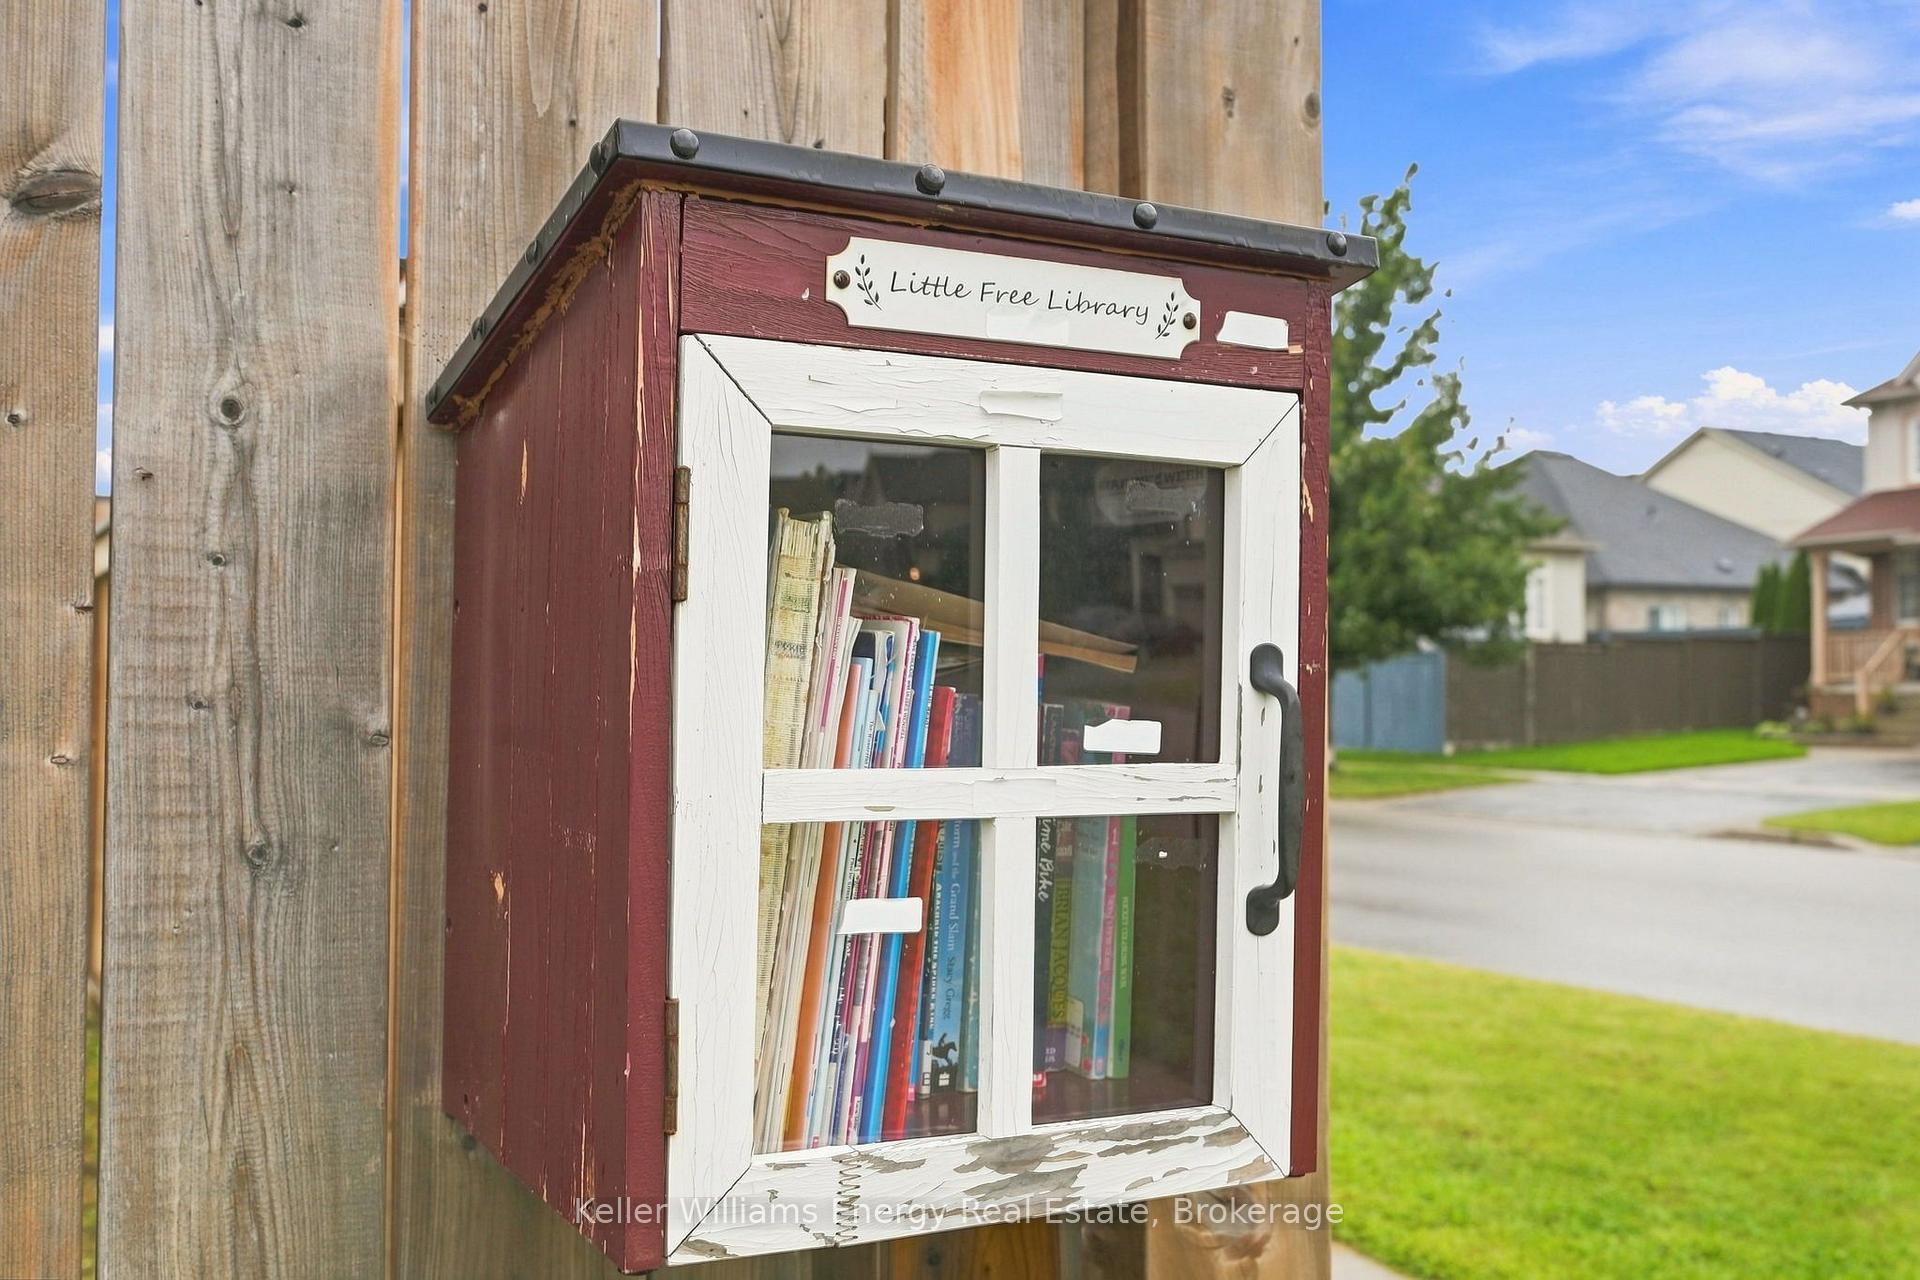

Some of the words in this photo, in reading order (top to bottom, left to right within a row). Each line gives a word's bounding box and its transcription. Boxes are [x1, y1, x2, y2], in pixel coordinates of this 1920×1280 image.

[890, 271, 972, 298] Little
[979, 282, 1039, 306] Free
[1047, 290, 1150, 325] Library
[1040, 818, 1056, 853] ime
[1038, 858, 1054, 902] Bike
[949, 883, 960, 920] Grand
[1053, 886, 1069, 940] BRIAN
[947, 922, 959, 951] Slam
[944, 956, 955, 984] Stacy
[1050, 943, 1067, 1019] JACQUES
